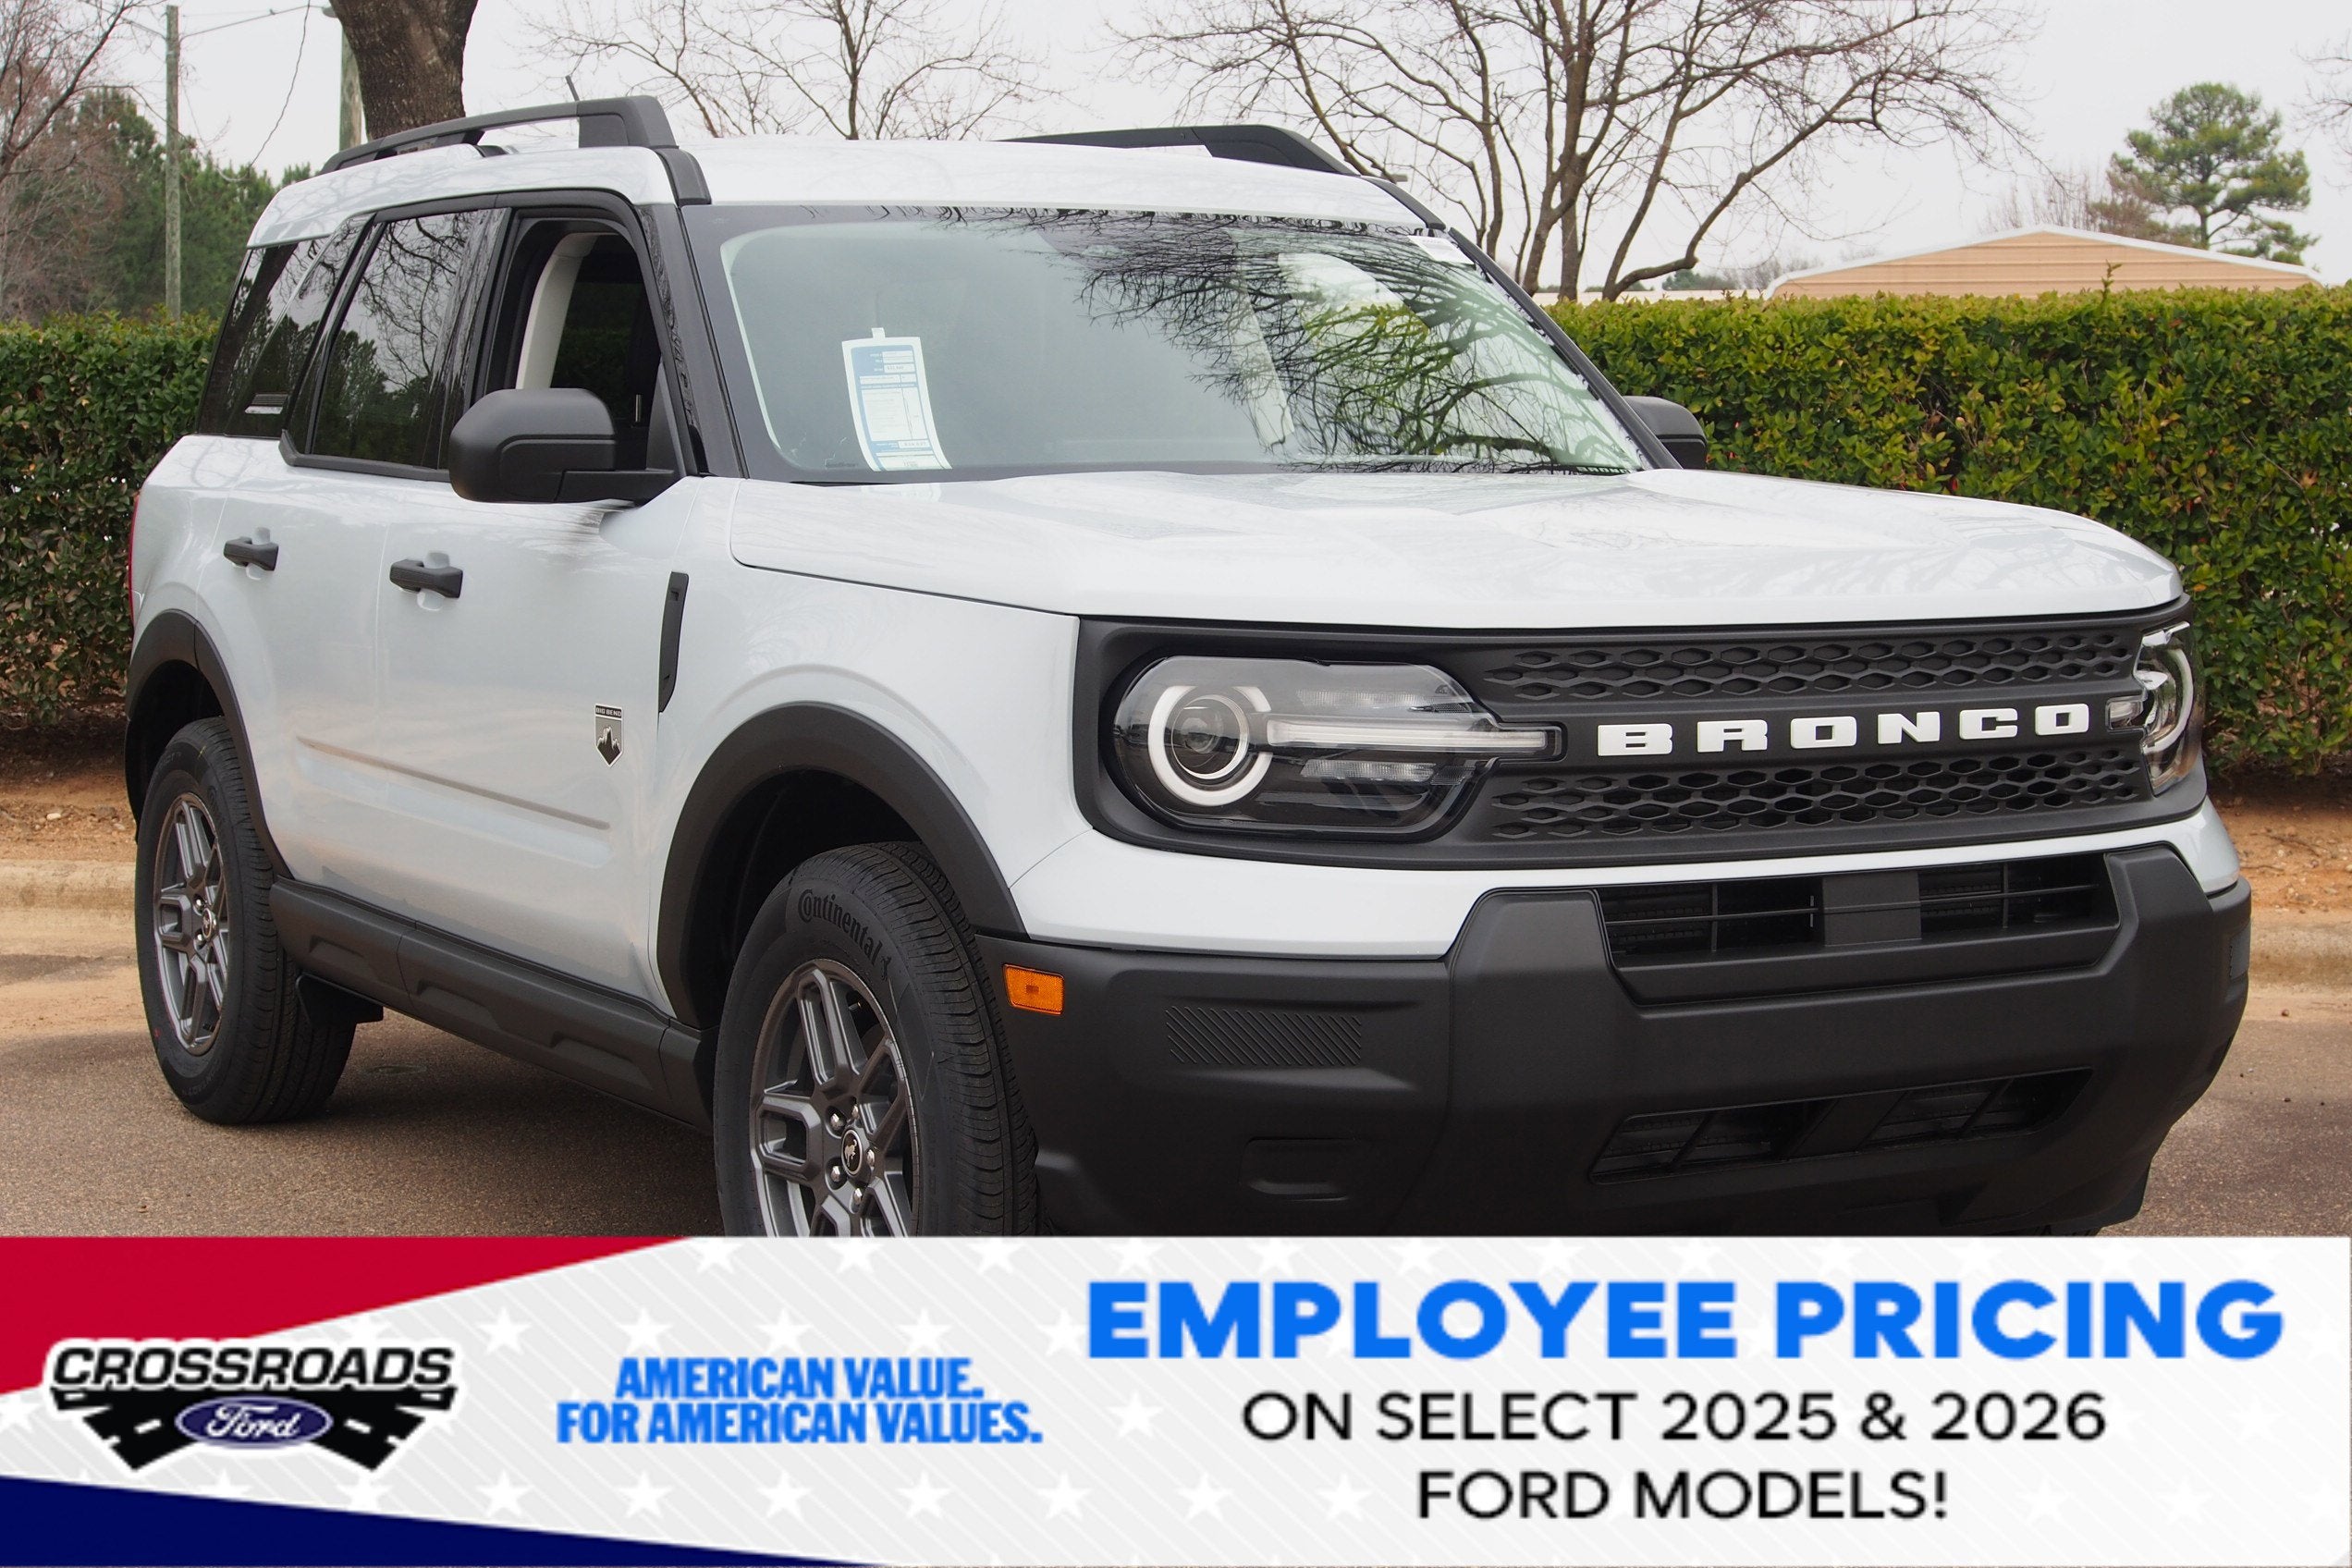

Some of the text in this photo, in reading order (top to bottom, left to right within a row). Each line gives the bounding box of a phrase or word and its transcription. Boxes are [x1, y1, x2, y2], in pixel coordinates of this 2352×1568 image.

[606, 708, 622, 717] BEND
[1598, 704, 2089, 756] BRONCO
[798, 888, 883, 966] Continental
